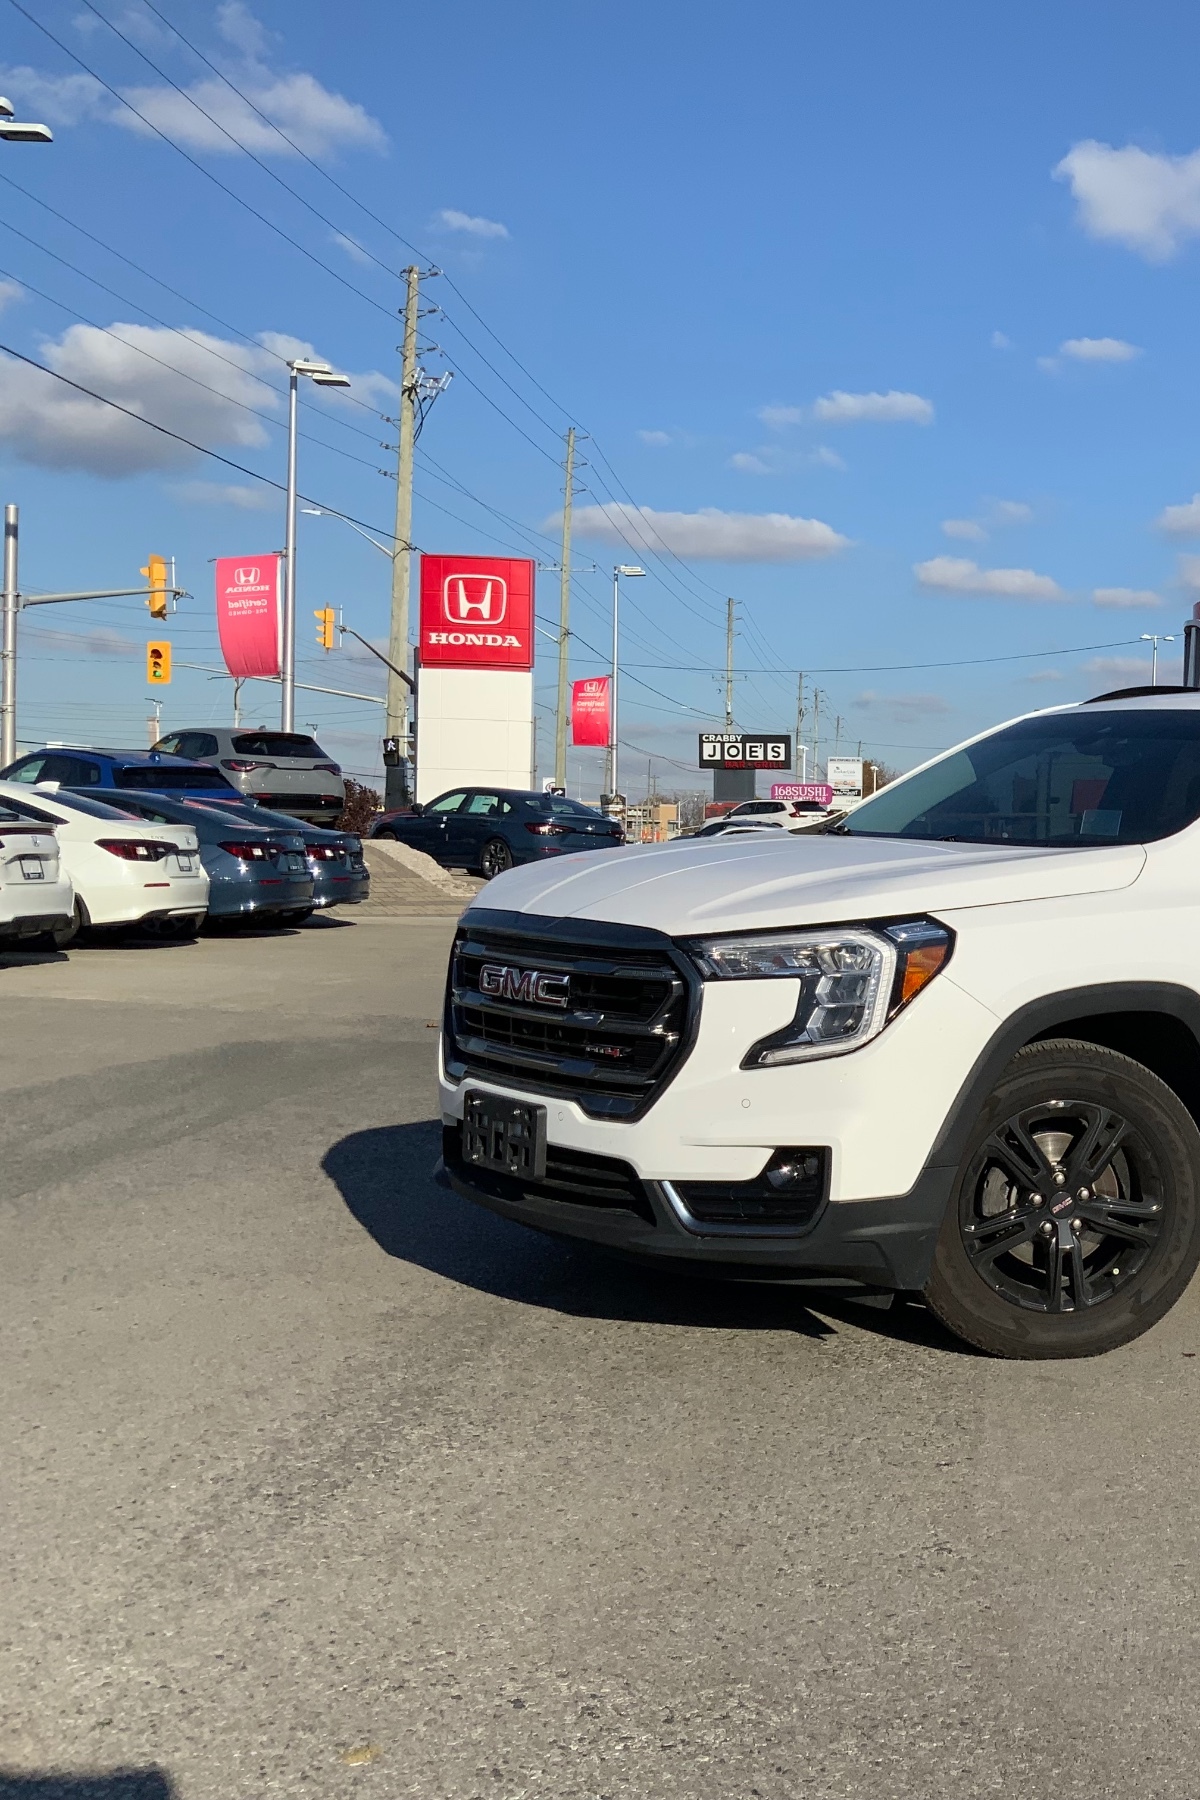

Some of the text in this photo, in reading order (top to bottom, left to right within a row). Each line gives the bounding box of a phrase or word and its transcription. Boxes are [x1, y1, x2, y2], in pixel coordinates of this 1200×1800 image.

[429, 632, 522, 647] HONDA
[702, 734, 742, 742] CRABBY
[707, 744, 781, 759] JOE'S
[725, 760, 784, 769] BAR GRILL
[479, 964, 571, 1008] GMC
